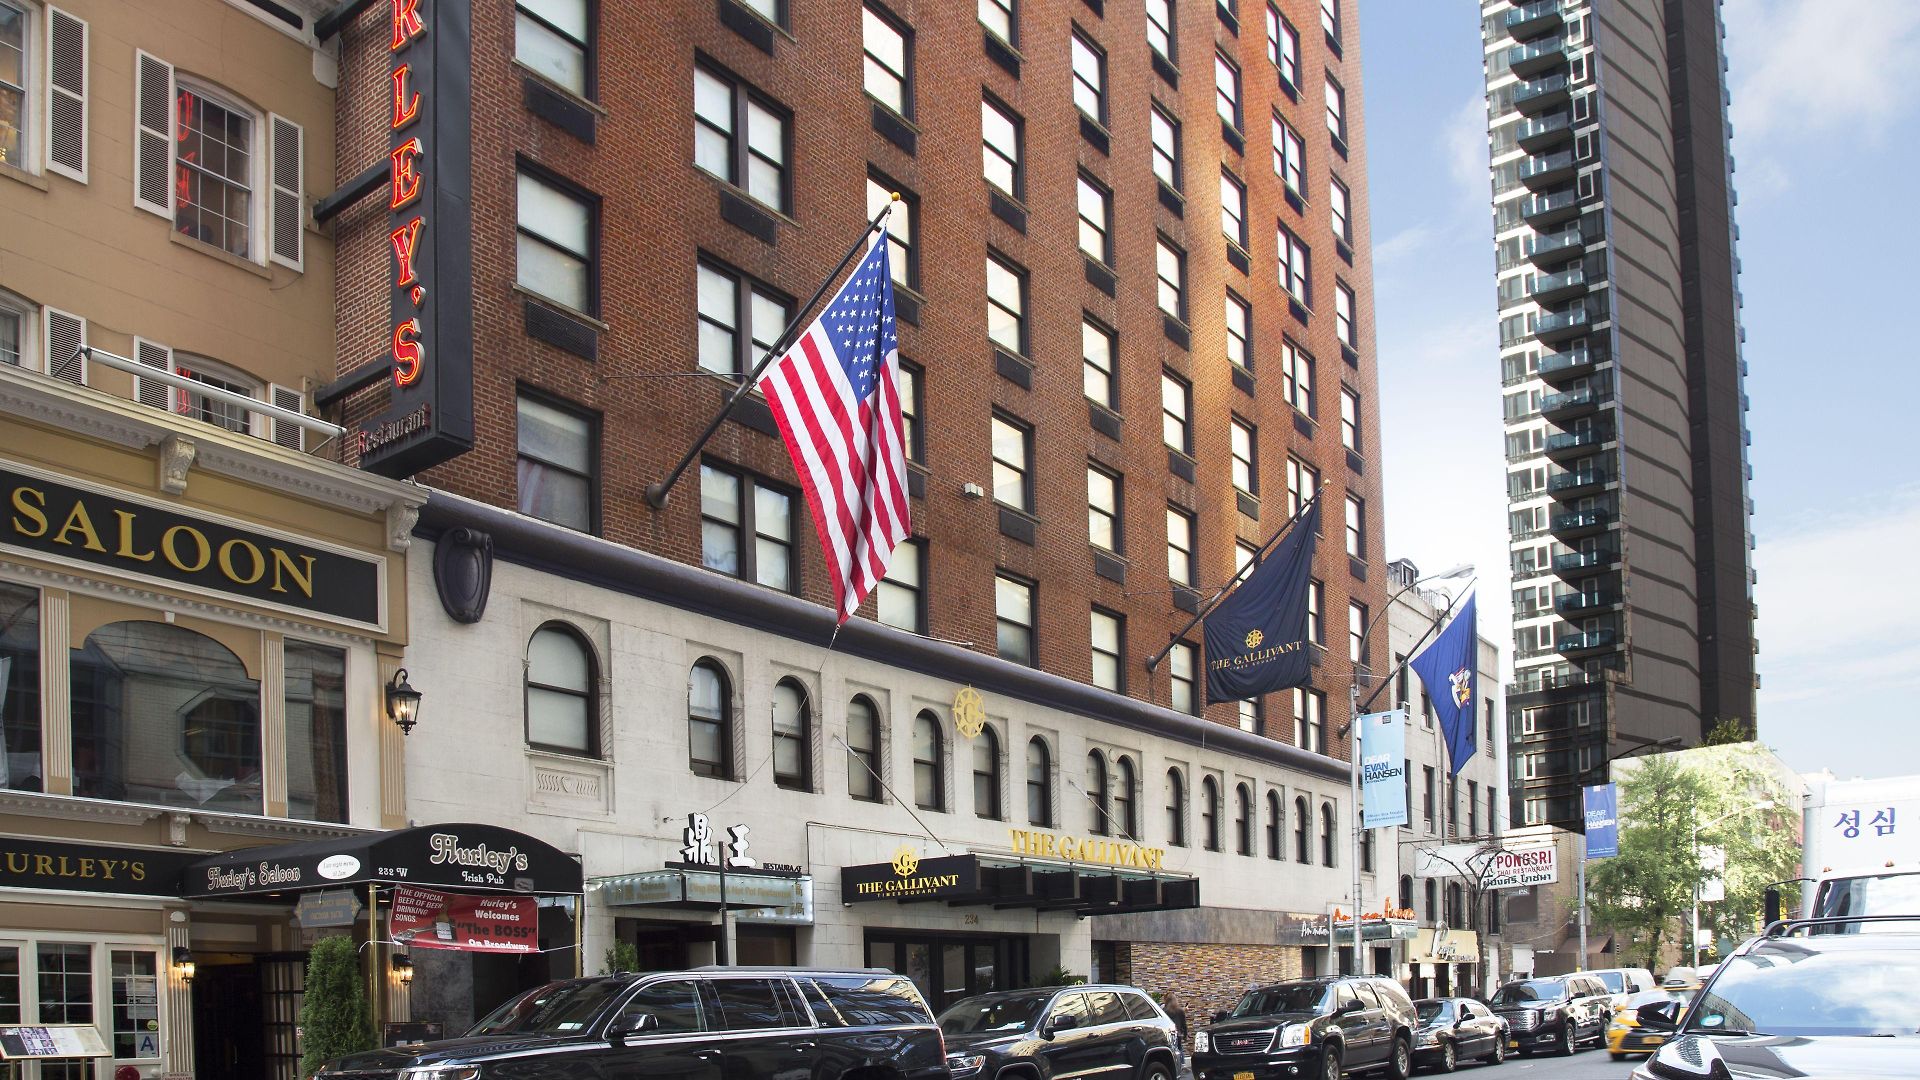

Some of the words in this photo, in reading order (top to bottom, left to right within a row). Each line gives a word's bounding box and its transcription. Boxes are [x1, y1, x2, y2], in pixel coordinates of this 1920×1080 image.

[358, 403, 431, 455] Restaurant
[11, 486, 317, 598] SALOON
[1234, 641, 1302, 666] GALLIVANT
[1364, 762, 1389, 773] EVAN
[1364, 768, 1402, 781] HANSEN
[1586, 809, 1606, 817] DEAR
[1586, 819, 1616, 828] HANSEN
[430, 833, 528, 873] Hurley's
[1008, 828, 1055, 857] THE
[1059, 836, 1166, 870] GALLIVANT
[0, 852, 146, 881] URLEY'S
[1496, 850, 1552, 869] PONGSRI
[208, 866, 255, 891] Hurley's
[258, 861, 300, 885] Saloon
[378, 867, 394, 876] 232
[395, 867, 408, 877] W
[1512, 864, 1553, 875] RESTAURANT
[462, 871, 484, 883] Irish
[486, 873, 504, 885] Pub
[857, 881, 883, 894] THE
[885, 874, 959, 891] GALLIVANT
[400, 888, 413, 896] THE
[414, 890, 443, 902] OFFICIAL
[904, 888, 937, 896] SQUARE
[396, 905, 428, 915] DRINKING
[398, 897, 415, 906] BEER
[416, 899, 425, 908] OF
[426, 901, 443, 909] BEER
[480, 900, 517, 910] Hurley's
[394, 914, 418, 923] SONGS.
[475, 909, 520, 922] Welcomes
[964, 914, 979, 925] 234
[456, 922, 490, 936] "The
[494, 925, 536, 938] BOSS"
[468, 938, 483, 947] On
[483, 939, 529, 952] Broadway
[140, 1035, 155, 1052] A
